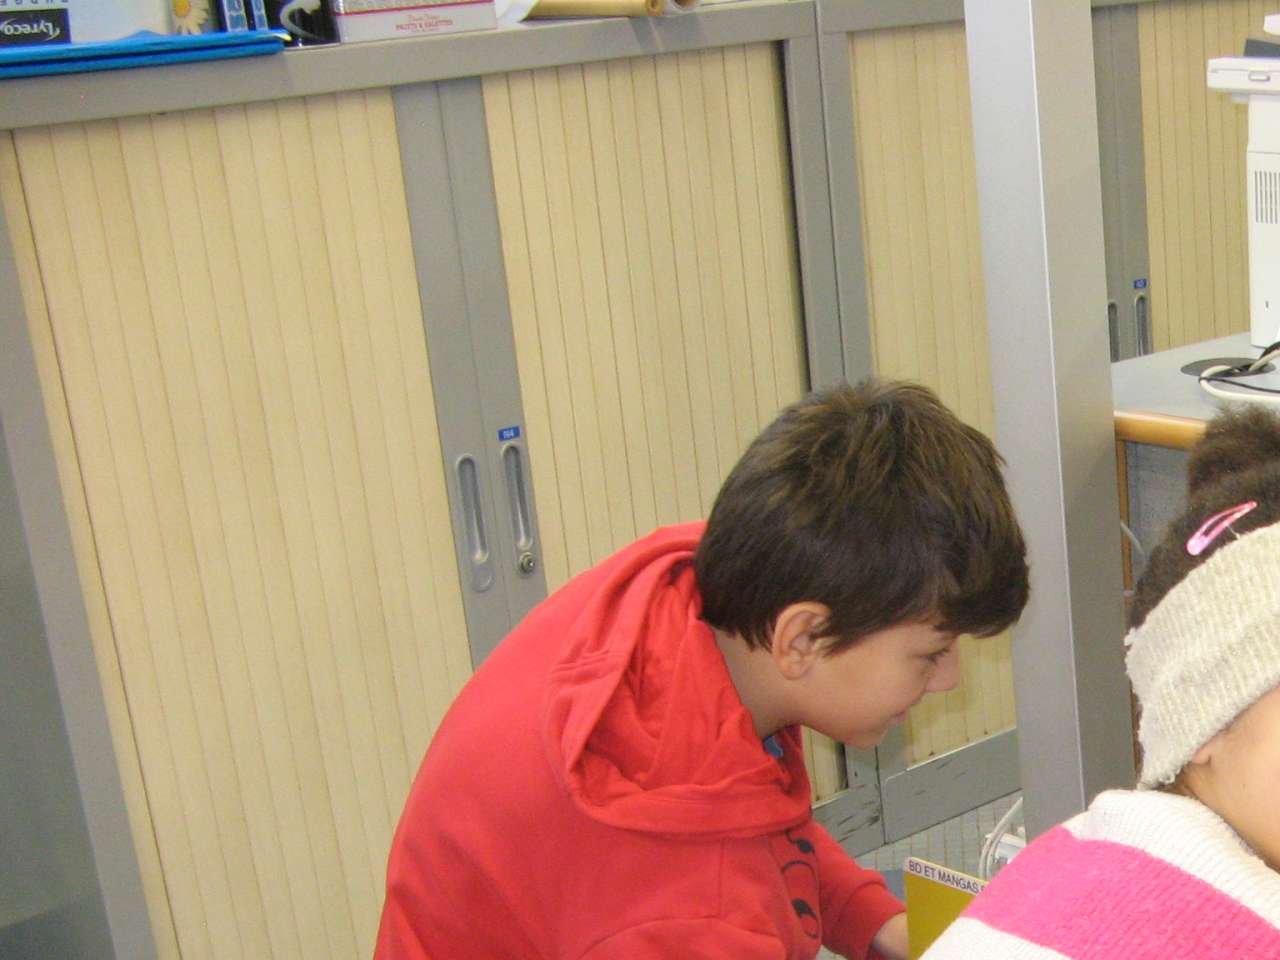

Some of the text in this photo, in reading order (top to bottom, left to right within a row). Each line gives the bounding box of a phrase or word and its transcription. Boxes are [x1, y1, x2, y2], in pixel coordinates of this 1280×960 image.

[4, 20, 53, 36] Lyreco
[908, 860, 922, 873] BD
[924, 865, 936, 878] ET
[938, 870, 979, 894] MANGAS
